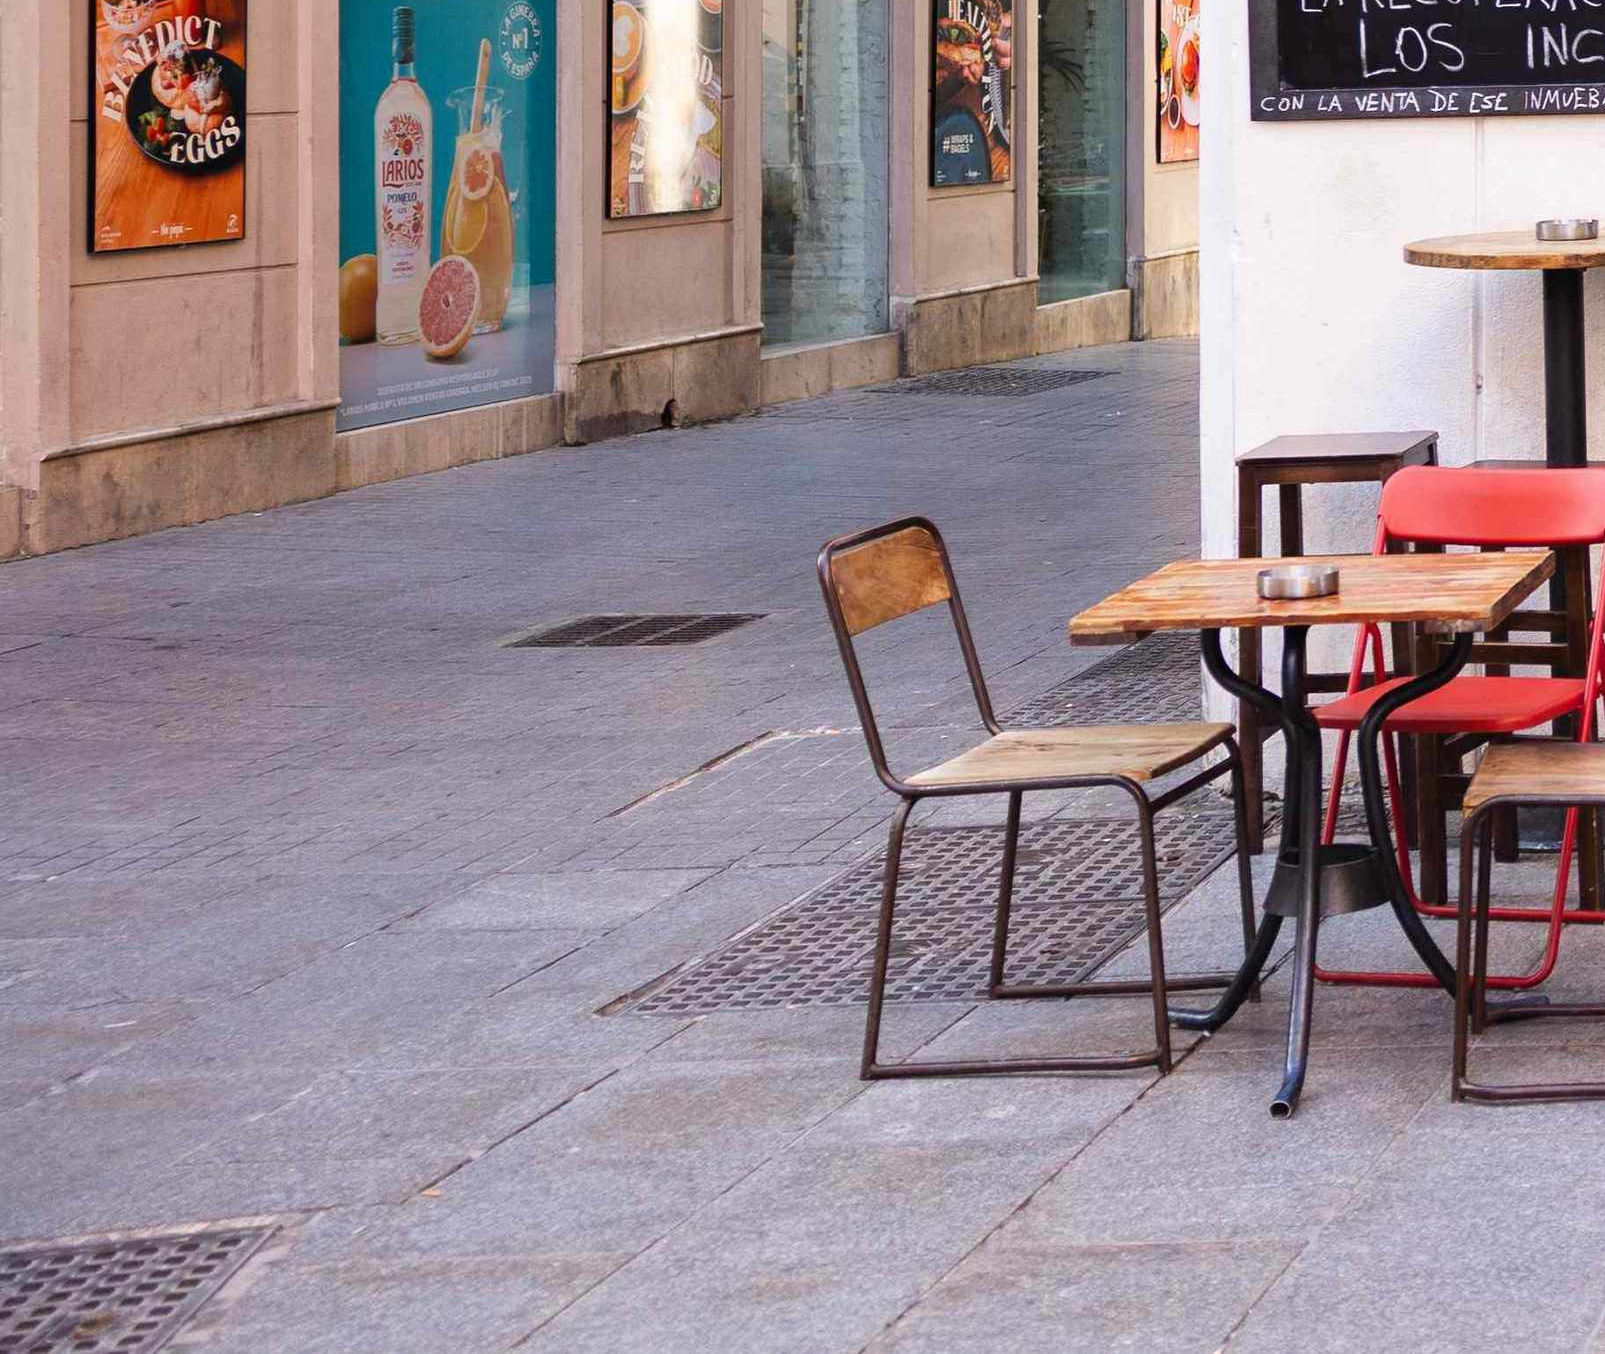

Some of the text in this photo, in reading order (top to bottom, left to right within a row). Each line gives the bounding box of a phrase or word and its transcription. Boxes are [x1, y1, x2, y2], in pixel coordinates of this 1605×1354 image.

[102, 14, 221, 122] BENEDICT
[1359, 19, 1465, 78] LOS
[1260, 94, 1304, 112] CON
[1317, 94, 1343, 112] LA
[1355, 91, 1421, 113] VENTA
[1428, 89, 1463, 113] DE
[1469, 92, 1509, 113] ESE
[169, 115, 242, 164] EGGS
[382, 158, 424, 188] LARIOS
